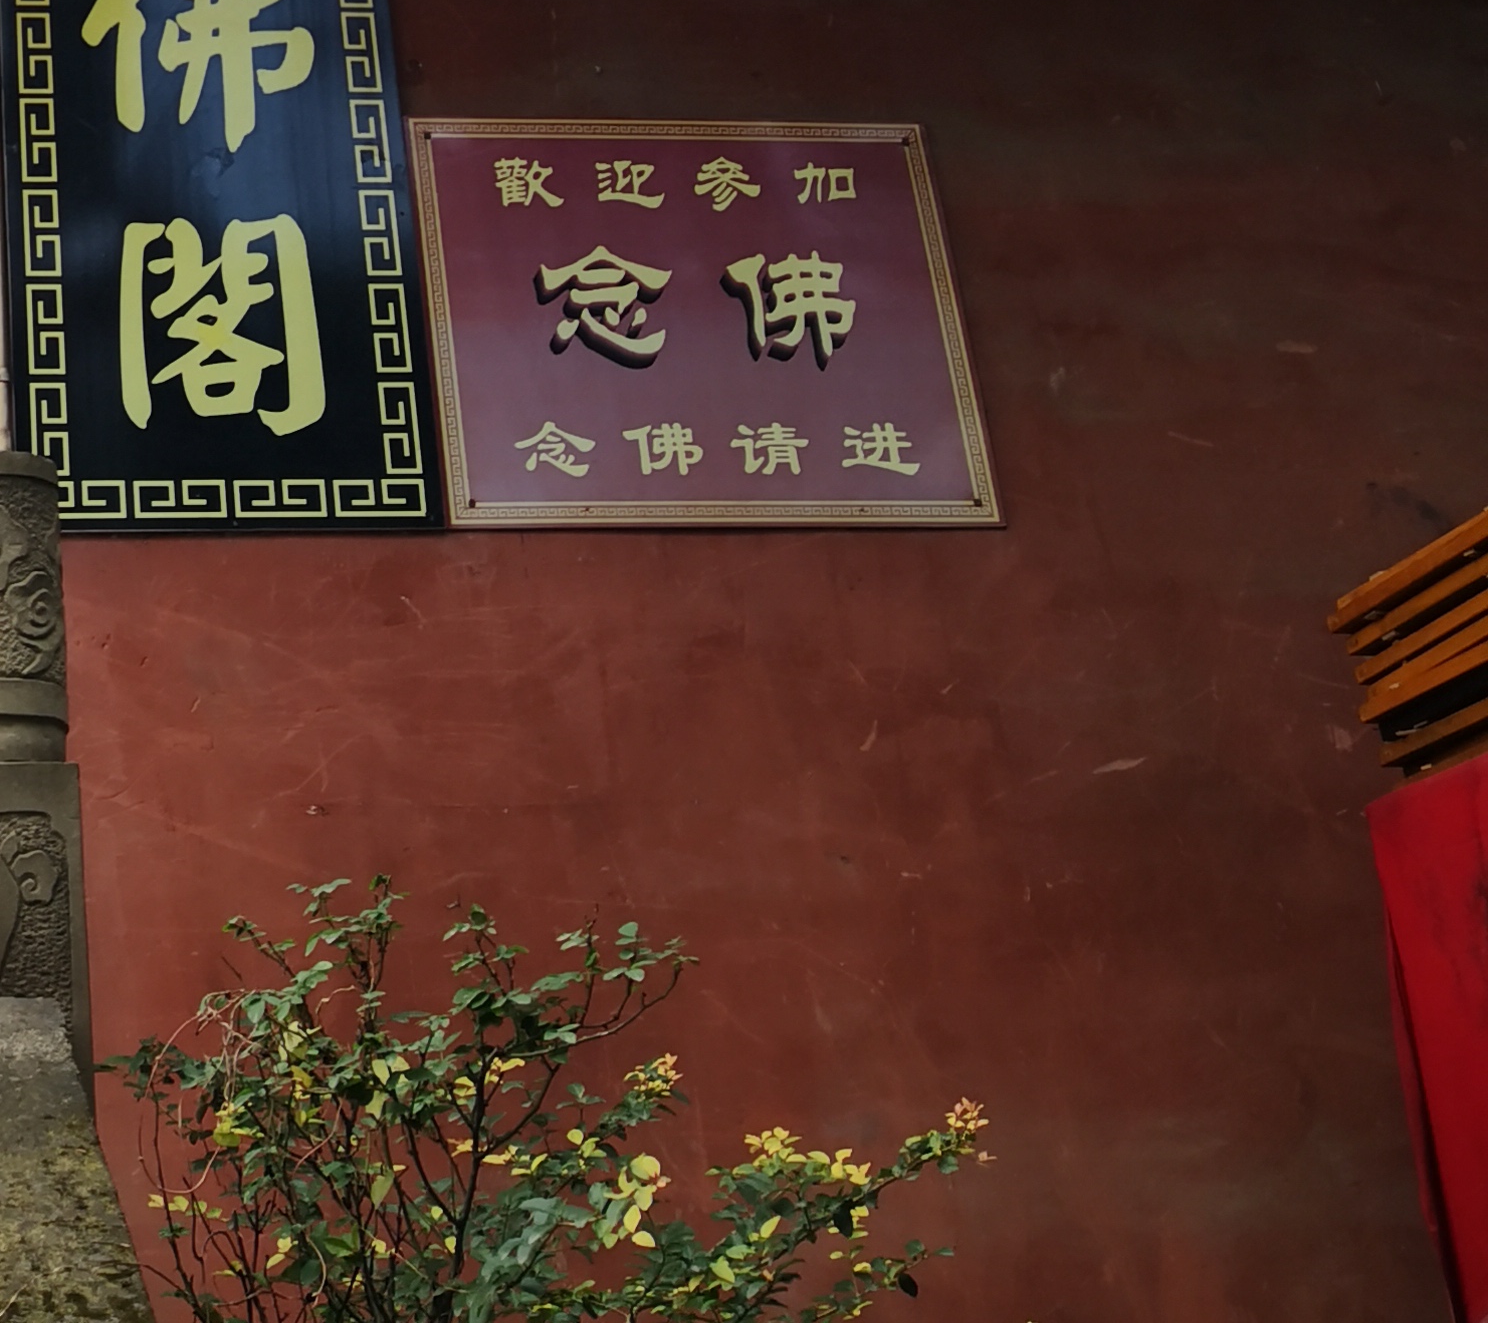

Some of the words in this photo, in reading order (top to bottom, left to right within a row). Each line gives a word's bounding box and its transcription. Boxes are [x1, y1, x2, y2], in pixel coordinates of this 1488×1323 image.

[494, 156, 858, 212] 歡迎參加
[532, 244, 857, 371] 念佛
[514, 420, 923, 478] 念佛请进
